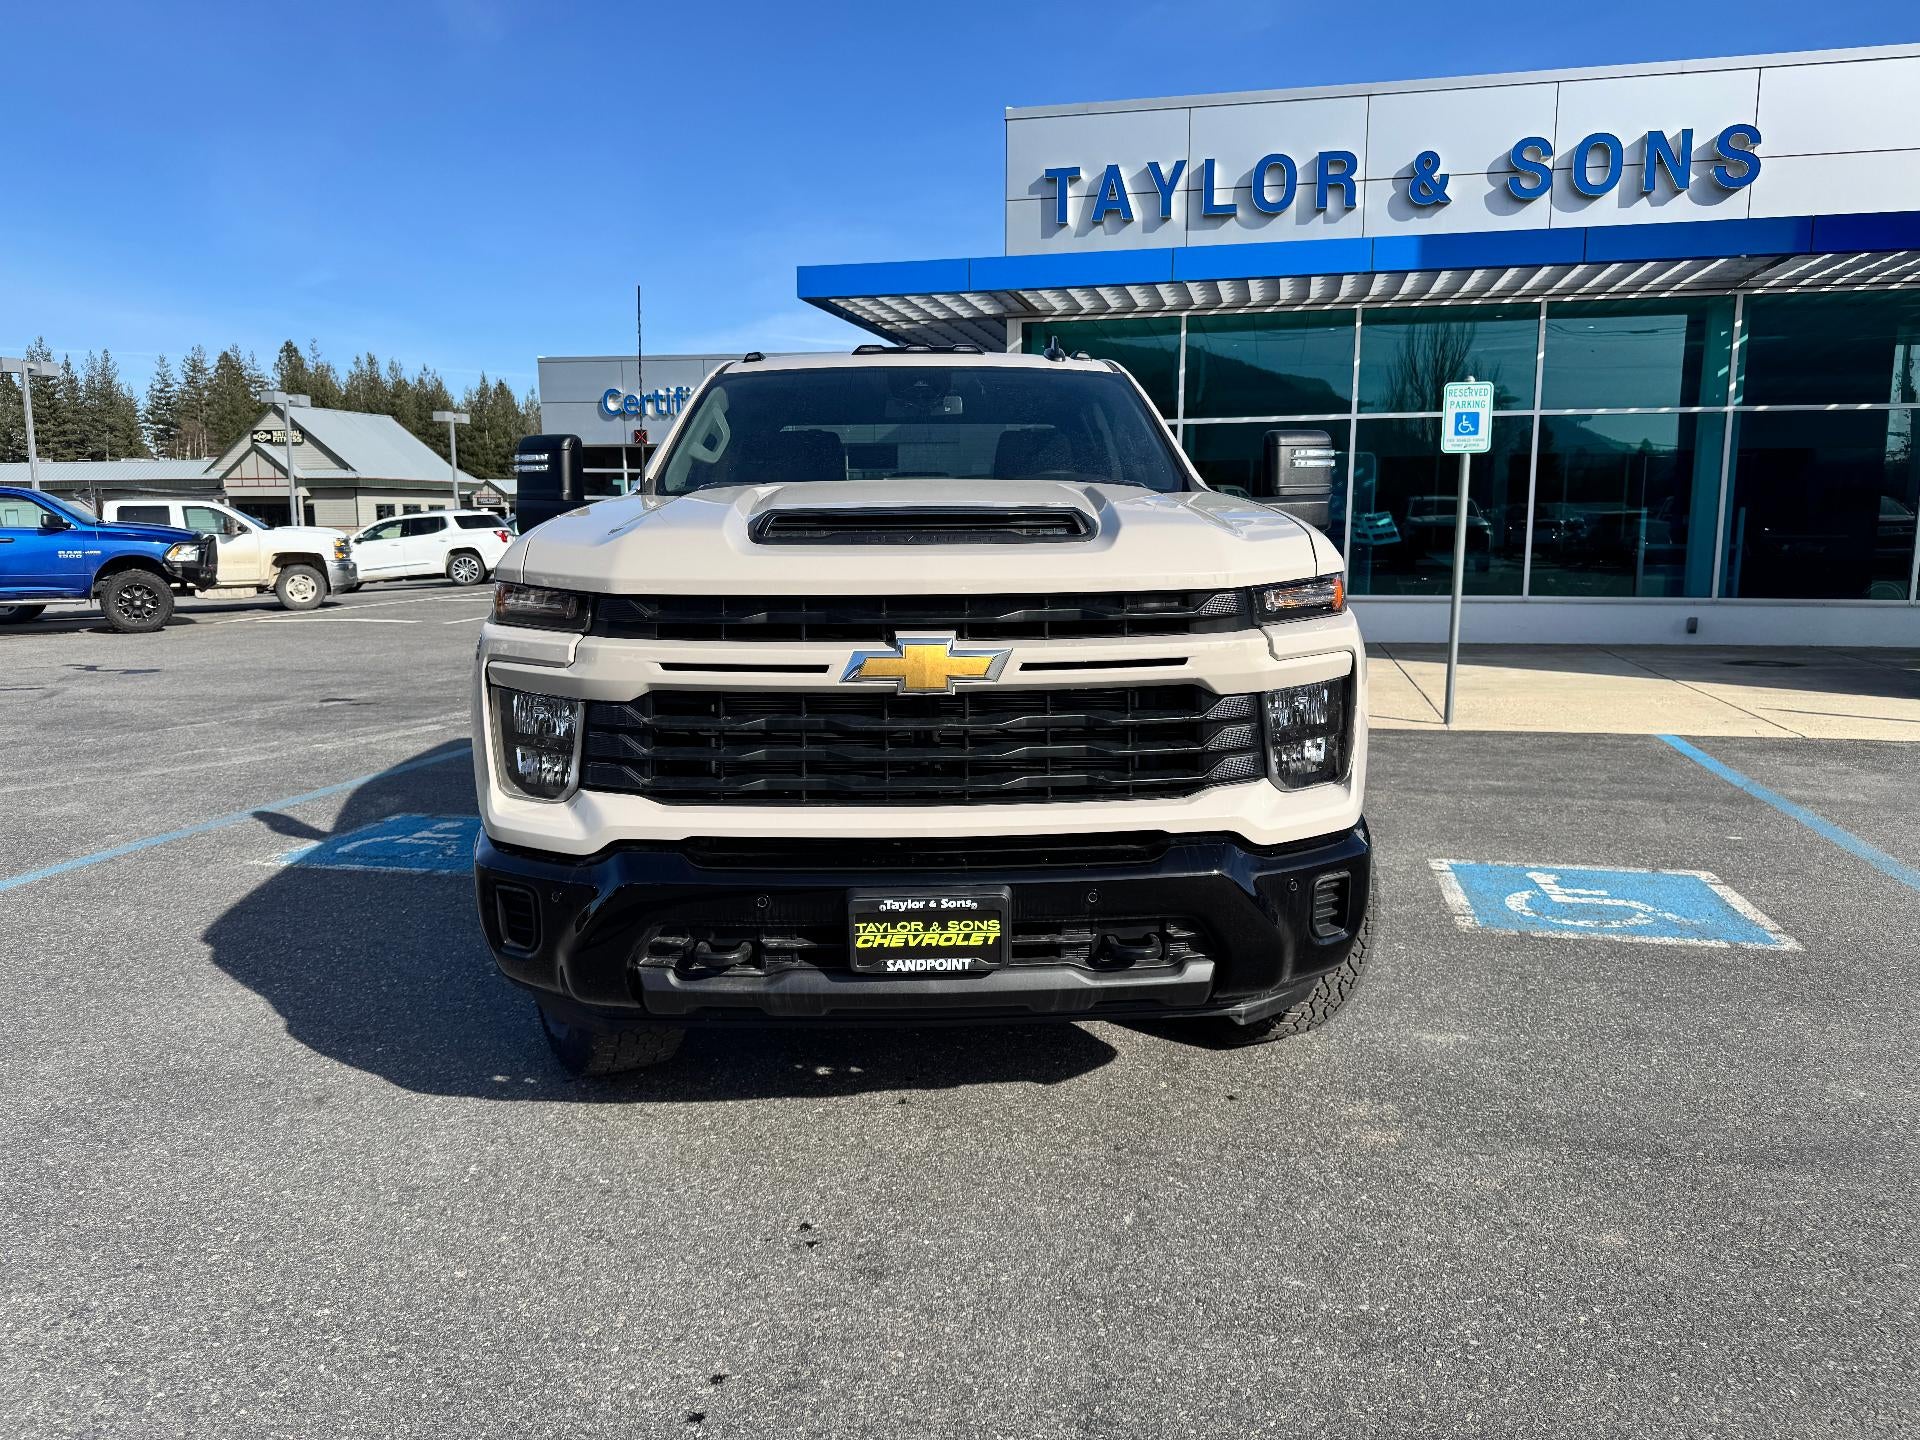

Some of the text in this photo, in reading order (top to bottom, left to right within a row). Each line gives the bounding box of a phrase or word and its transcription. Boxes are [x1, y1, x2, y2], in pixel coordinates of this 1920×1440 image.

[1044, 124, 1763, 226] TAYLOR & SONS
[1448, 388, 1489, 397] RESERVED
[1449, 400, 1486, 409] PARKING
[883, 899, 972, 911] Taylor & Sons
[855, 920, 1001, 933] TAYLOR & SONS
[856, 933, 1001, 948] CHEVROLET
[886, 959, 971, 971] SANDPOINT
